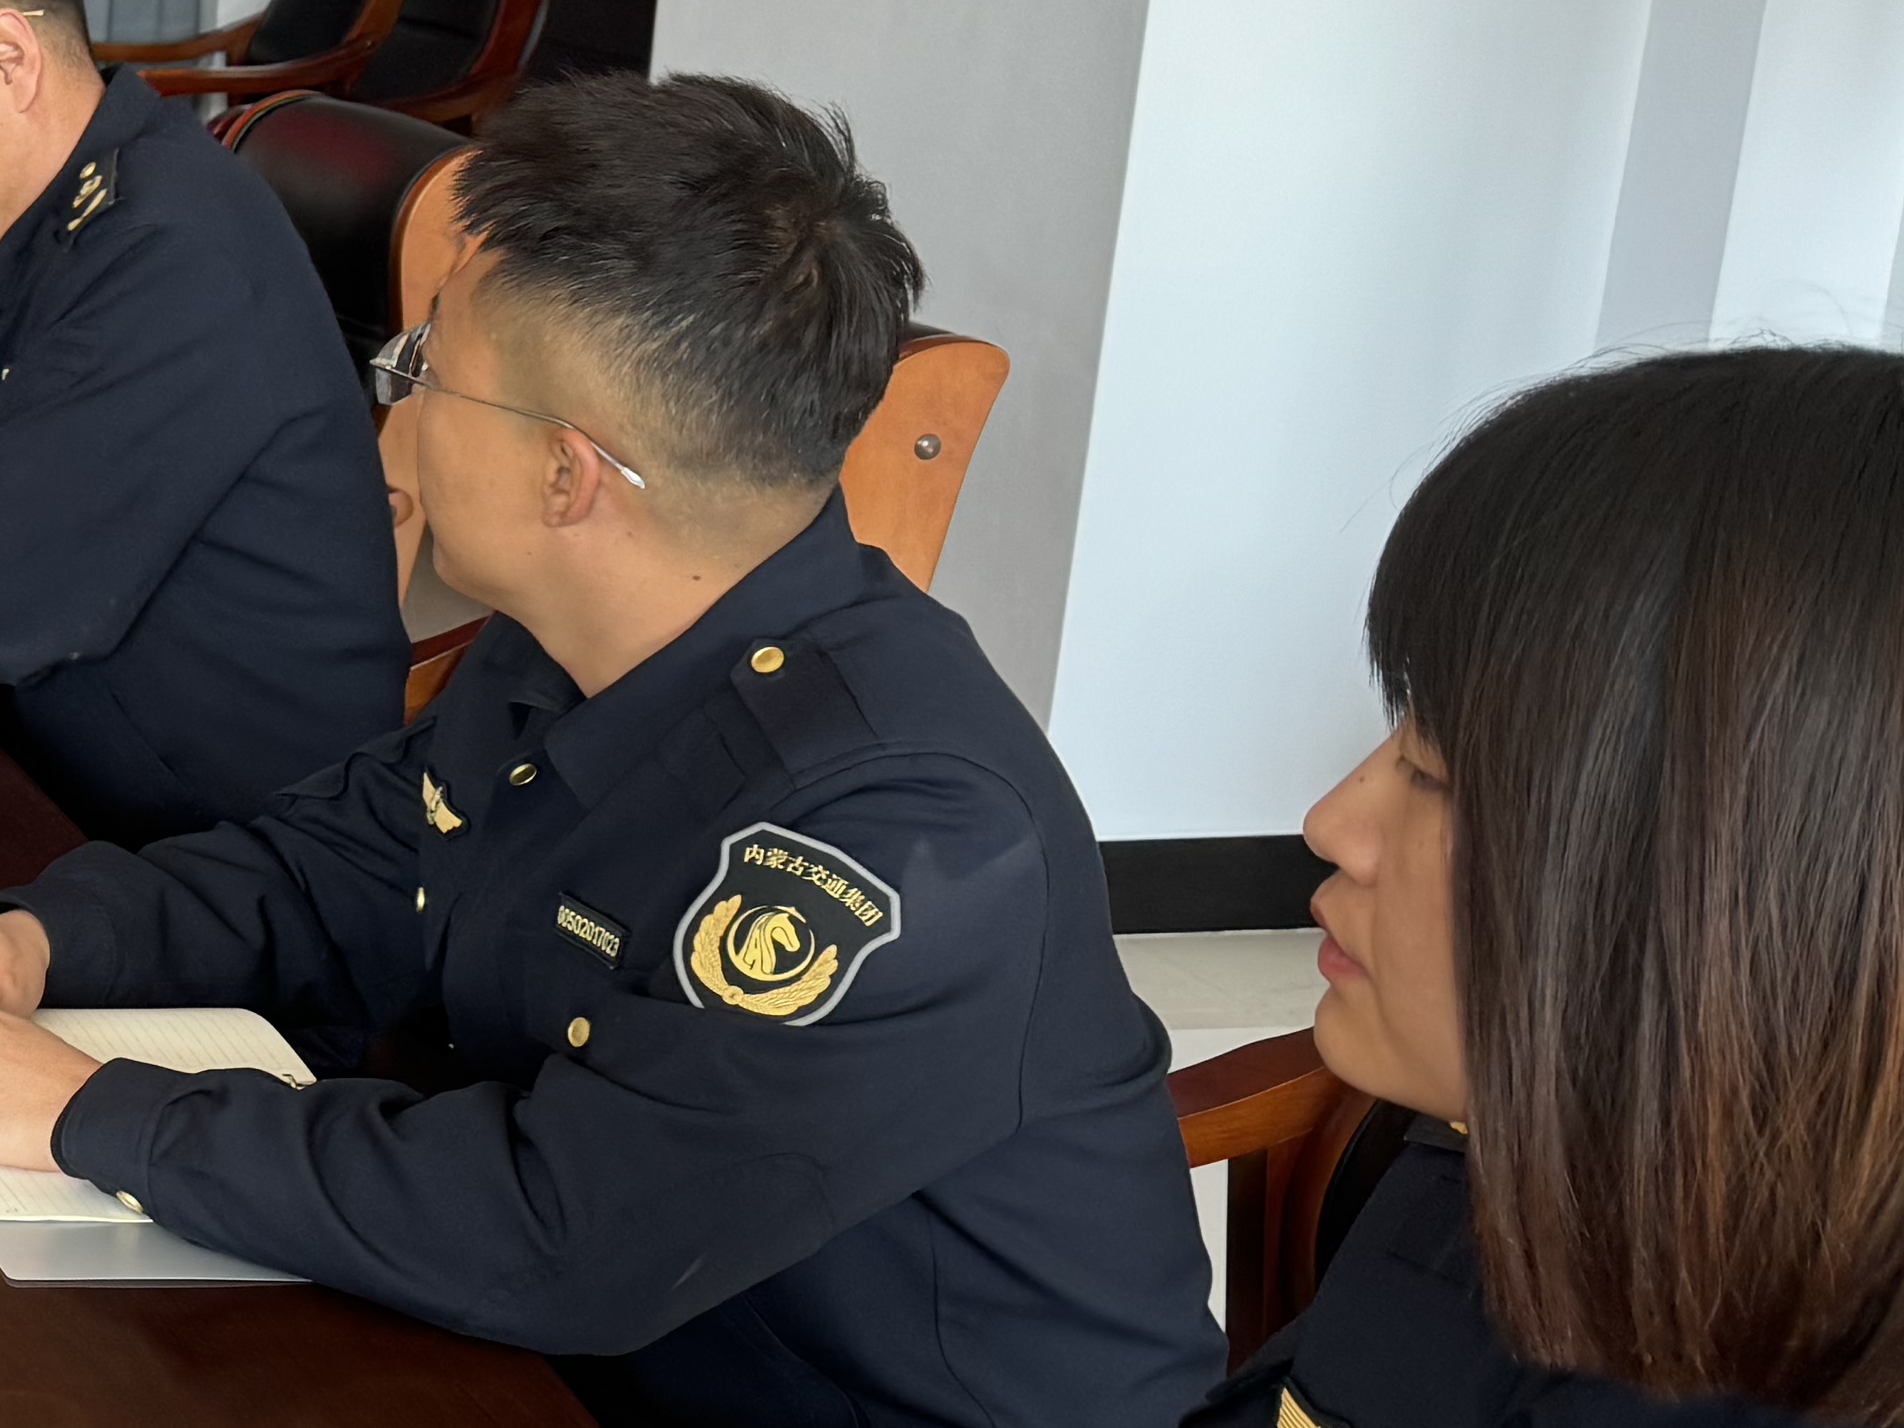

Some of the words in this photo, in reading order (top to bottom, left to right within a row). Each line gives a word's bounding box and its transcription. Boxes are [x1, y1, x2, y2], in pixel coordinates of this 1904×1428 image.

[743, 843, 884, 928] 内蒙古交通集团
